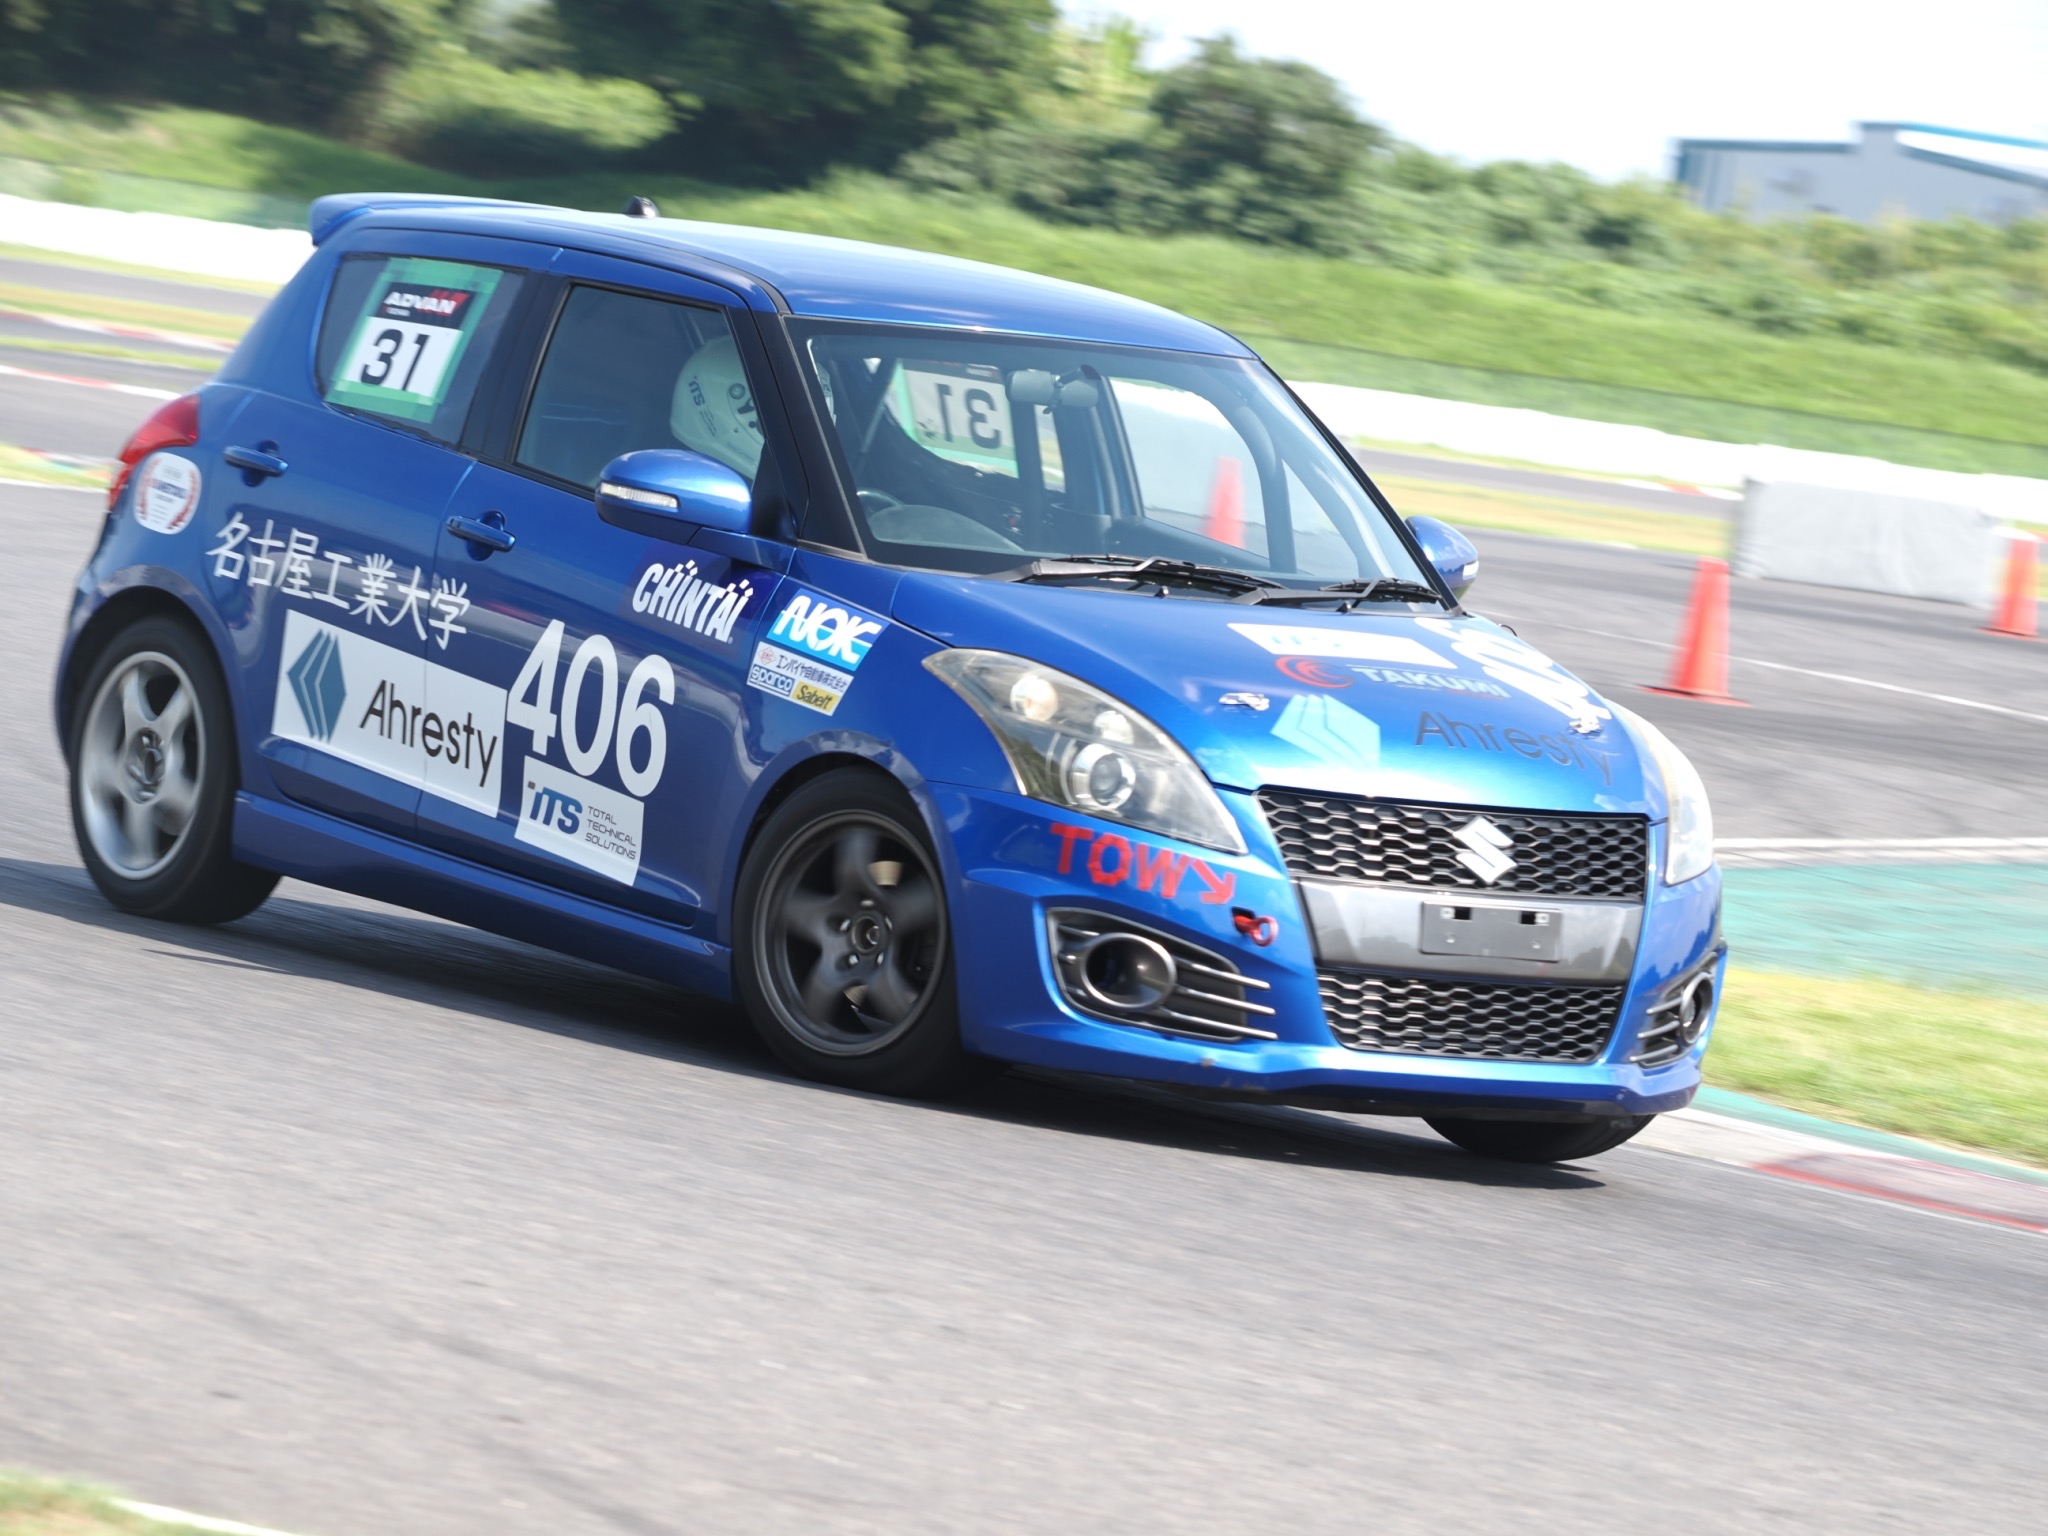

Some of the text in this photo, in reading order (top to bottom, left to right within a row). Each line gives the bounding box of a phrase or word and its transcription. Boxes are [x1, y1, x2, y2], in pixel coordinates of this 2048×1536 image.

[383, 291, 458, 315] ADVAN
[359, 327, 431, 392] 31
[206, 512, 471, 650] 名古屋工業大学
[773, 594, 882, 664] NOK
[507, 619, 675, 797] 406
[751, 665, 794, 692] sparco
[1350, 666, 1511, 698] TAKUMI
[360, 679, 497, 787] Ahresty
[1415, 711, 1612, 787] Ahresty
[585, 832, 637, 860] SOLUTIONS
[587, 805, 617, 825] TOTAL
[587, 819, 636, 847] TECHNICAL
[1051, 823, 1192, 898] TOW
